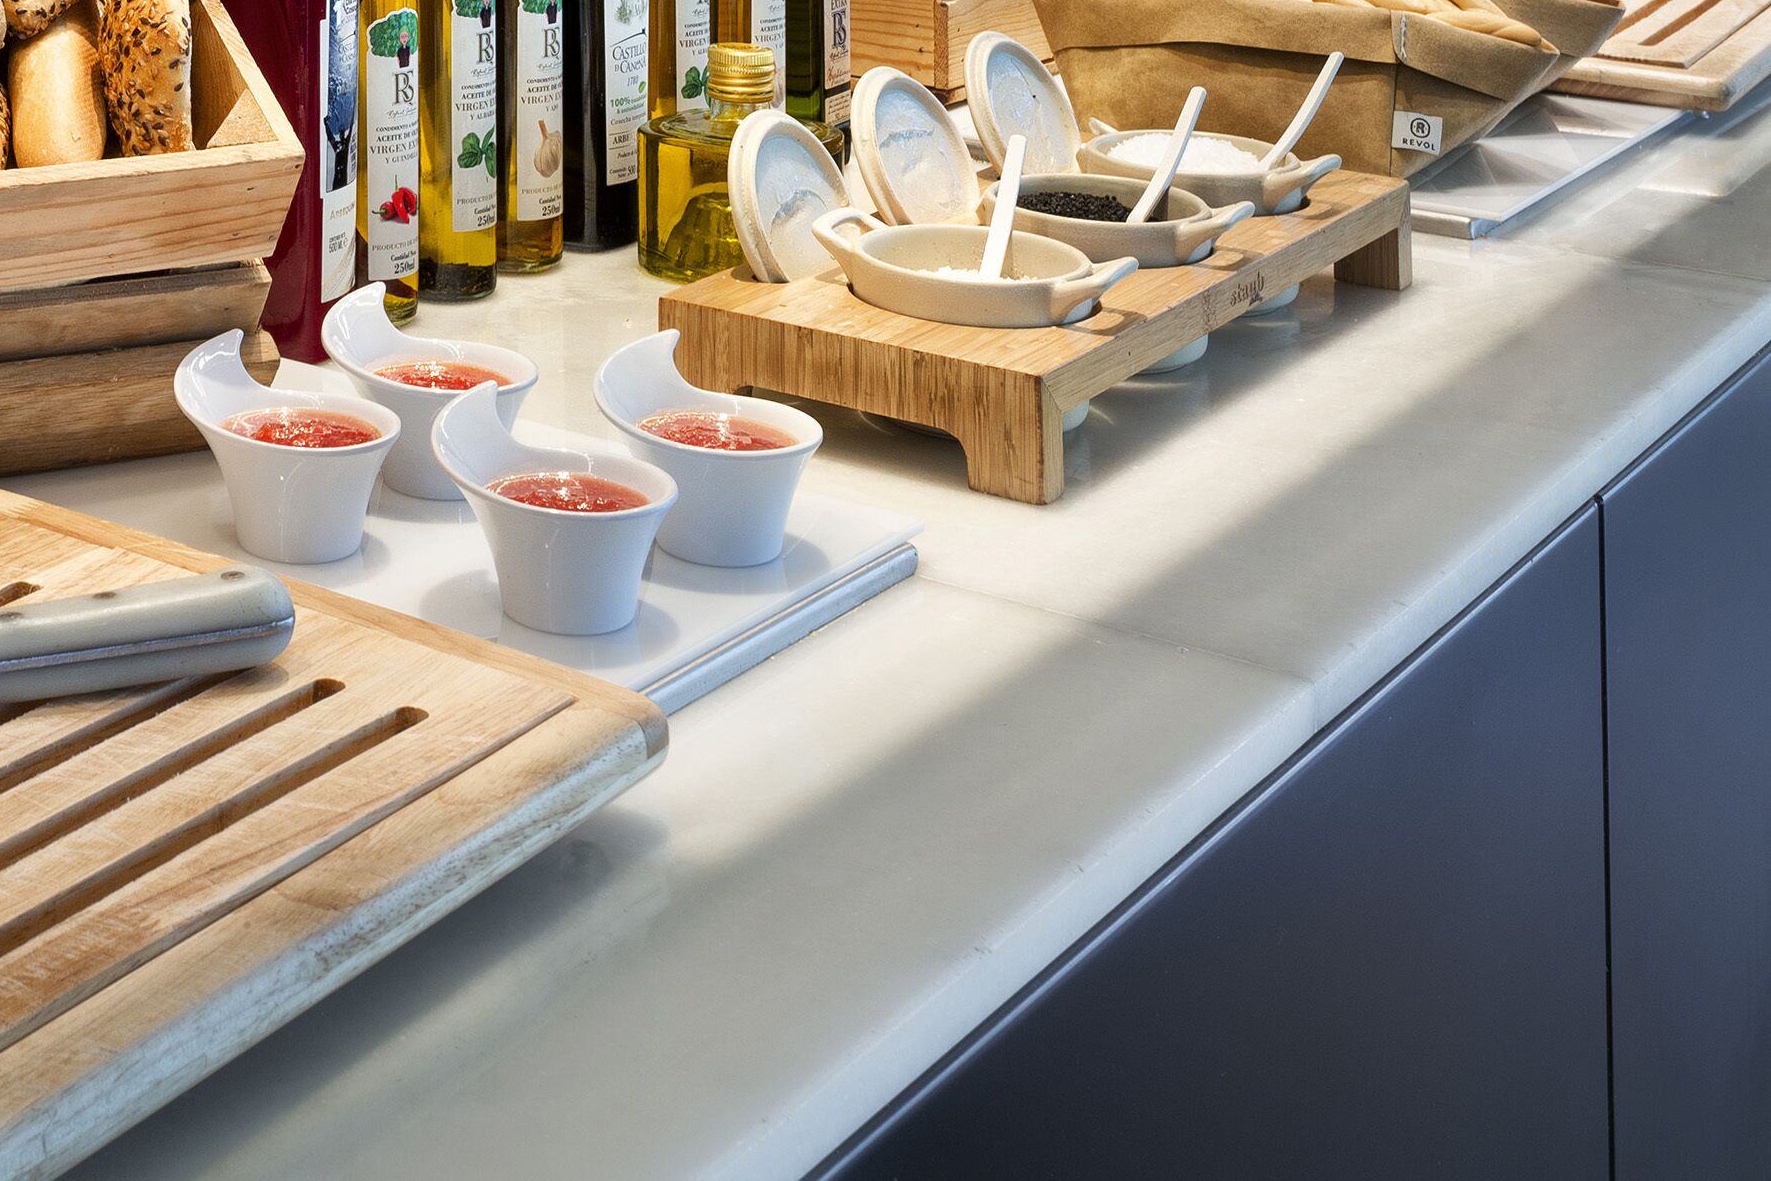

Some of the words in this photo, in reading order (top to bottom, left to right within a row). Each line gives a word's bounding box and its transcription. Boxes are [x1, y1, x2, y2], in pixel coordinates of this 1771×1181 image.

[679, 38, 707, 48] VIRGEN
[612, 41, 647, 61] CASTILLO
[461, 91, 485, 100] ACEITE
[526, 85, 550, 94] ACEITE
[520, 93, 554, 105] VIRGEN
[610, 96, 631, 108] 100%
[455, 100, 489, 112] VIRGEN
[376, 133, 403, 143] ACEITE
[1401, 137, 1436, 151] REVOL
[370, 142, 407, 155] VIRGEN
[394, 258, 416, 275] 250ml
